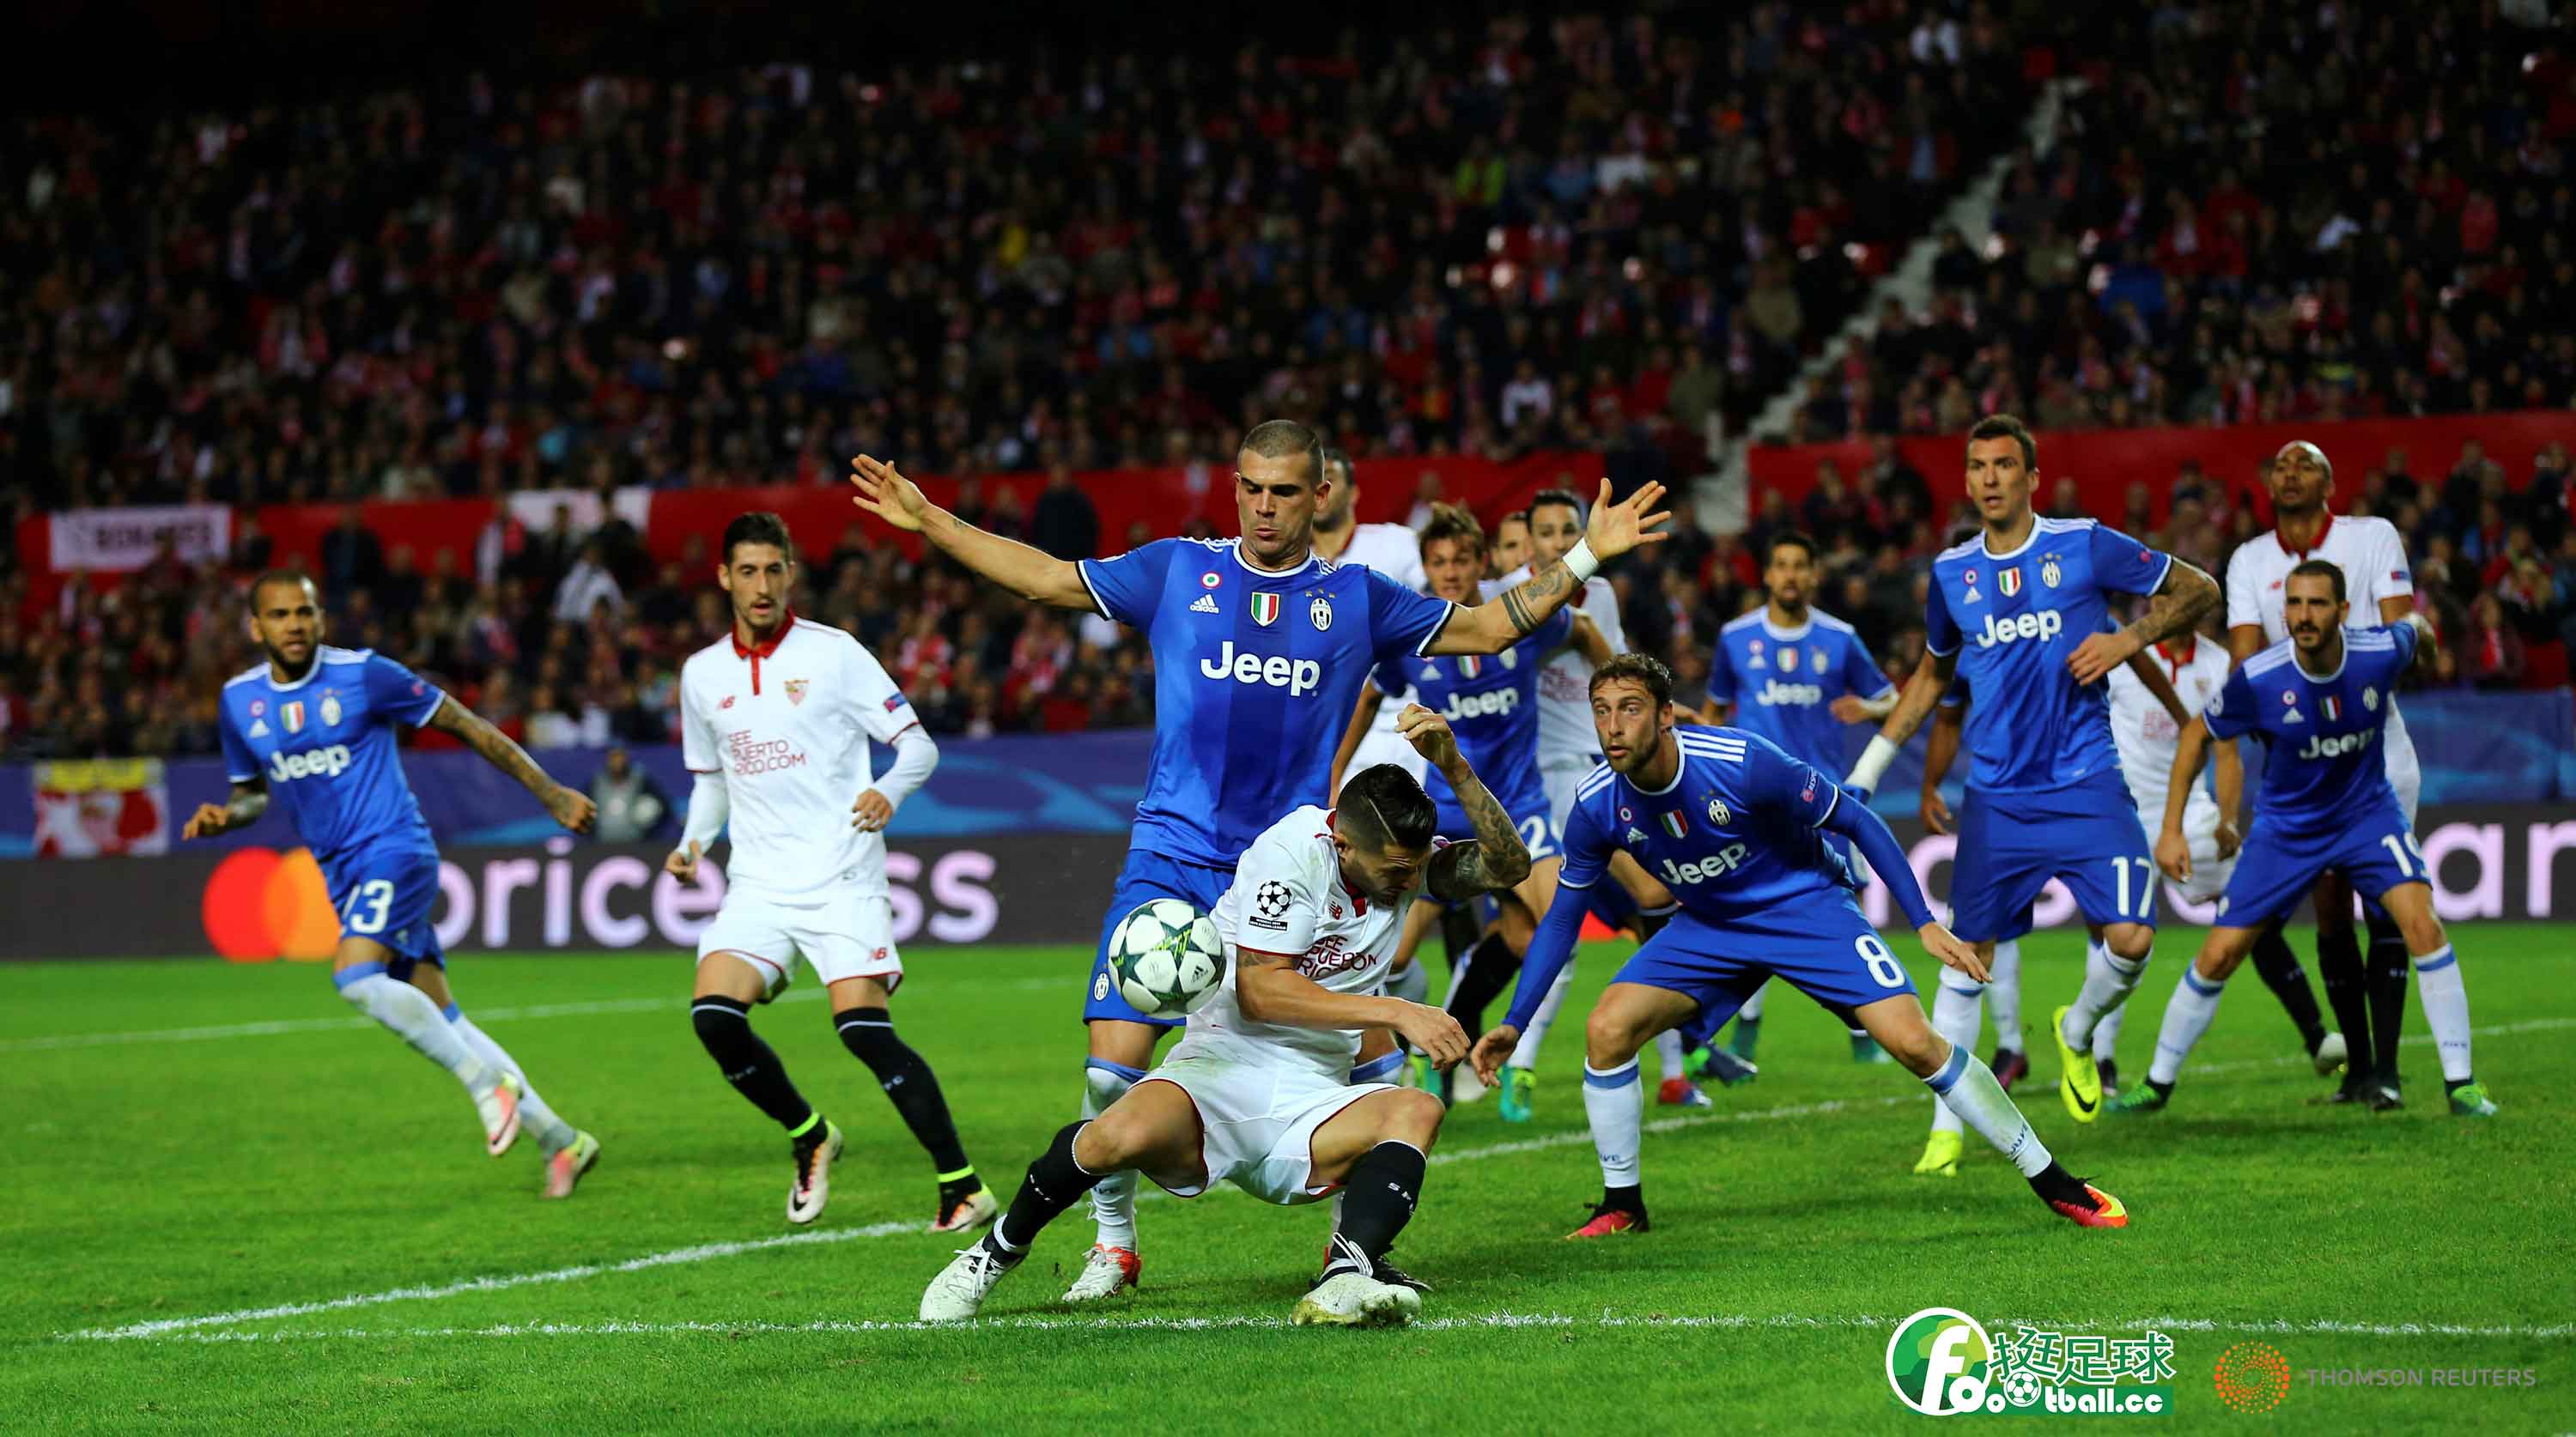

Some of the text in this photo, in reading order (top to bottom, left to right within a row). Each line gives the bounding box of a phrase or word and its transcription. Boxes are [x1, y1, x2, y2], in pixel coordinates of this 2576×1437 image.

[1977, 609, 2062, 649] Jeep
[1200, 640, 1321, 697] Jeep
[1441, 688, 1519, 721] Jeep
[1756, 679, 1822, 709] Jeep
[270, 744, 351, 783] Jeep
[1660, 843, 1747, 885] Jeep
[341, 879, 394, 934] 3
[2111, 856, 2153, 919] 17
[1854, 934, 1906, 989] 8
